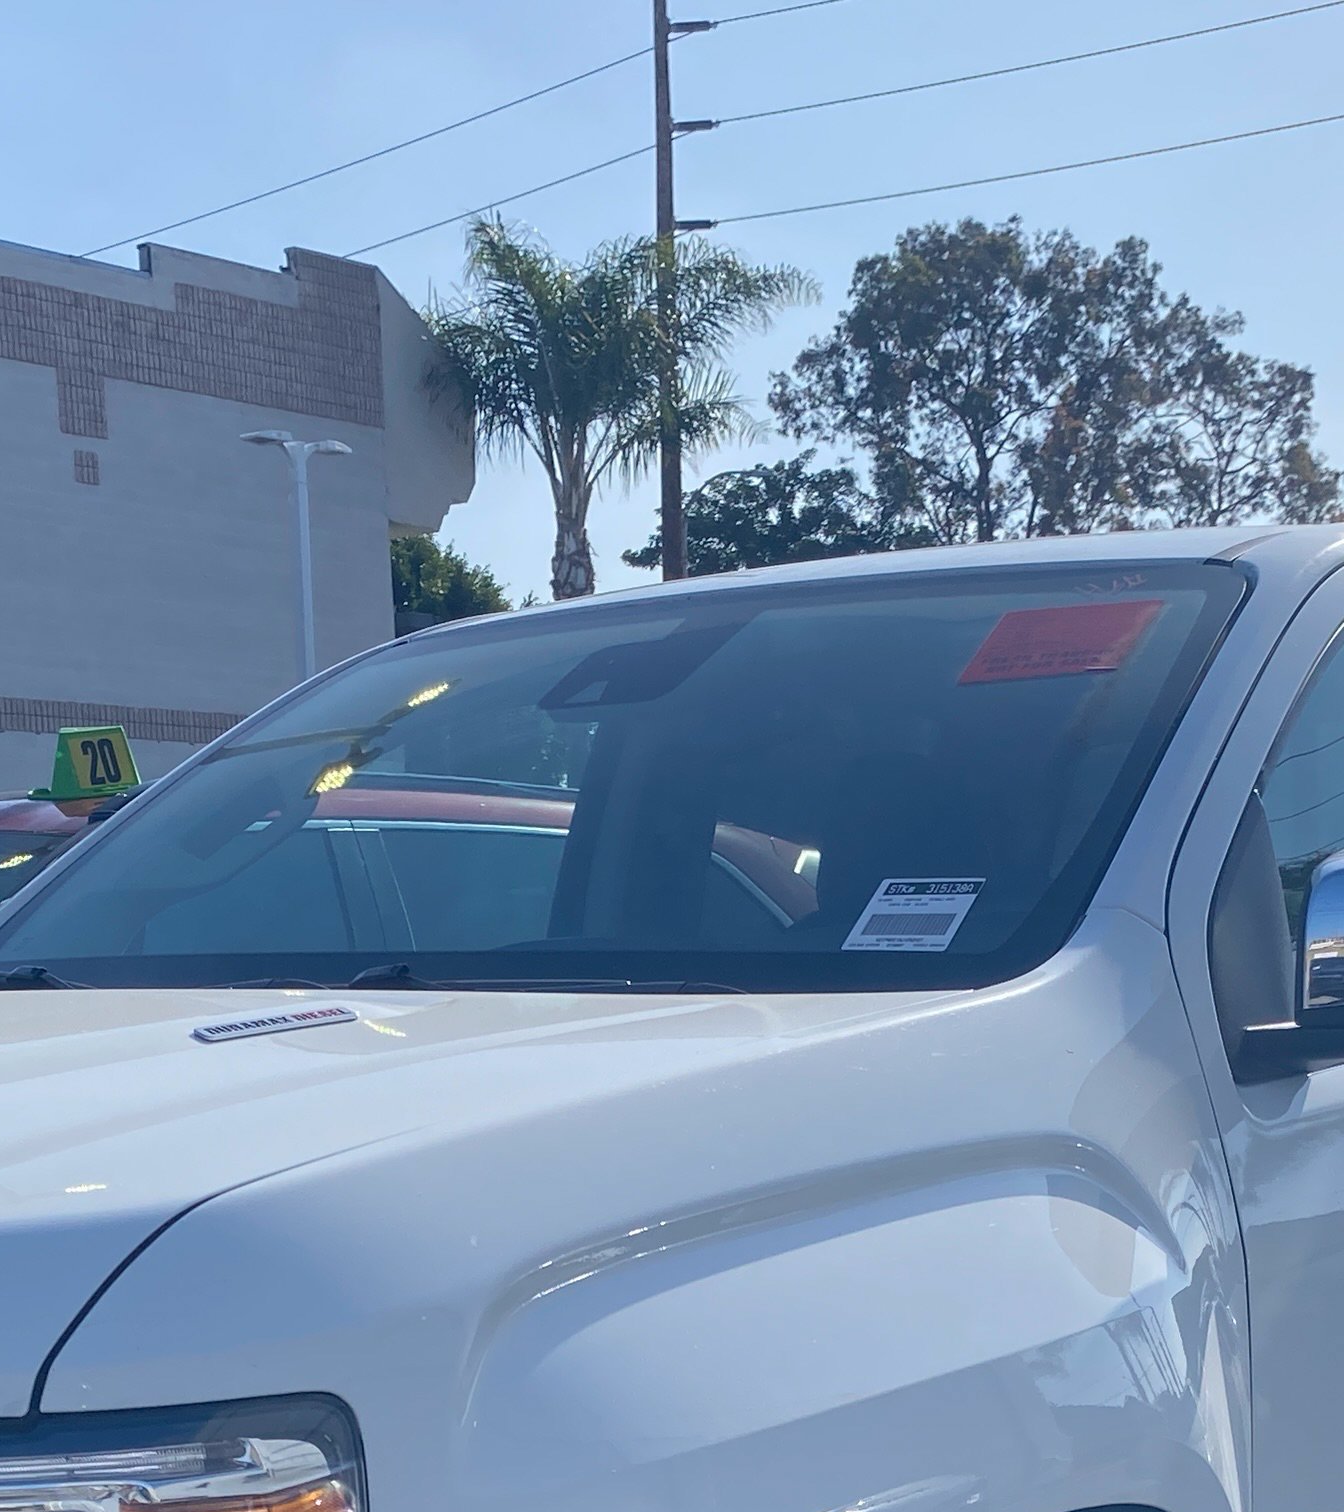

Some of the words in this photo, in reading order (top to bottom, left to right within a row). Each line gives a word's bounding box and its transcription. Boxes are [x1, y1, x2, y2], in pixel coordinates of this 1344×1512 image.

[80, 738, 121, 785] 20
[203, 1015, 293, 1036] DURAMAX
[290, 1007, 347, 1022] DIESEL
